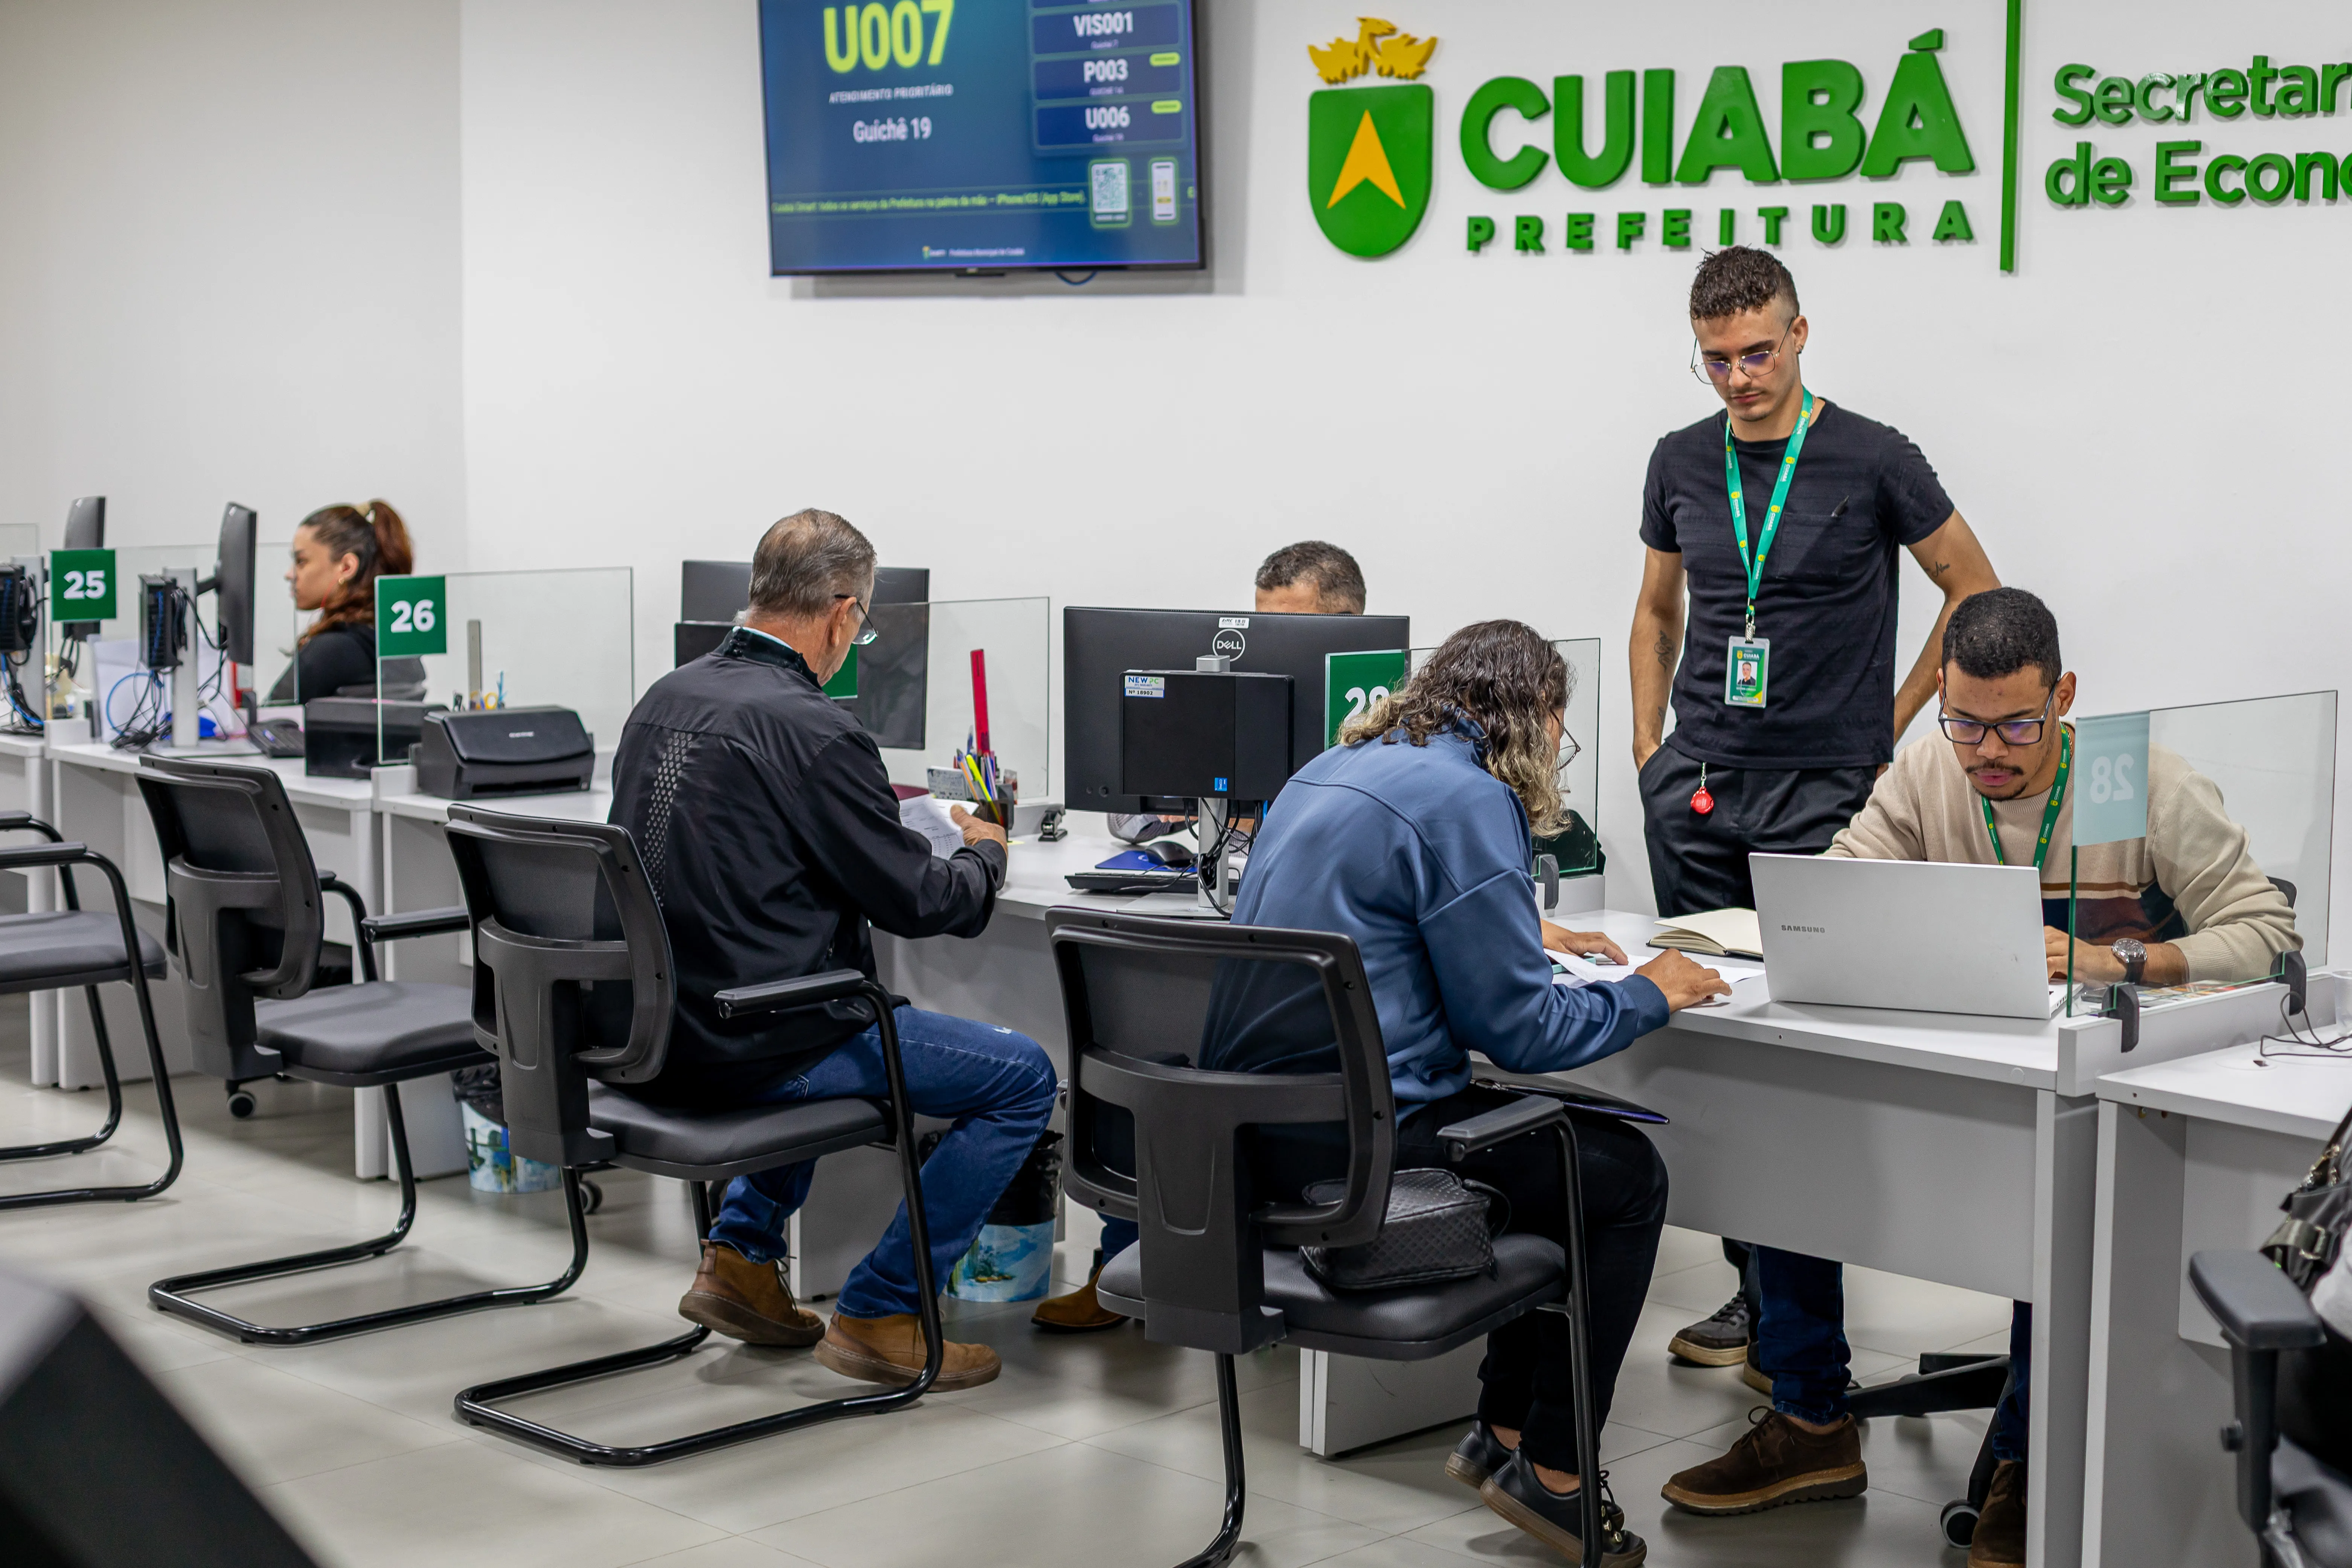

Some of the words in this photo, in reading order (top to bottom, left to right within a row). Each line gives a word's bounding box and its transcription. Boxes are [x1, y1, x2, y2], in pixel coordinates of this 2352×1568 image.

[823, 0, 955, 73] U007
[1073, 11, 1133, 37] VIS001
[1084, 59, 1128, 82] P003
[829, 88, 893, 104] ATENDIMENTO
[894, 83, 954, 99] PRIORITÁRIO
[2052, 55, 2352, 125] Secretar
[1085, 106, 1130, 130] U006
[1459, 28, 1975, 189] CUIABÁ
[853, 117, 908, 143] Guichê
[910, 116, 932, 139] 19
[2045, 141, 2132, 204] de
[2155, 140, 2352, 203] Econ
[1467, 200, 1975, 251] PREFEITURA
[63, 570, 106, 599] 25
[390, 599, 436, 633] 26
[1217, 640, 1242, 649] DELL
[1781, 925, 1825, 933] SAMSUNG
